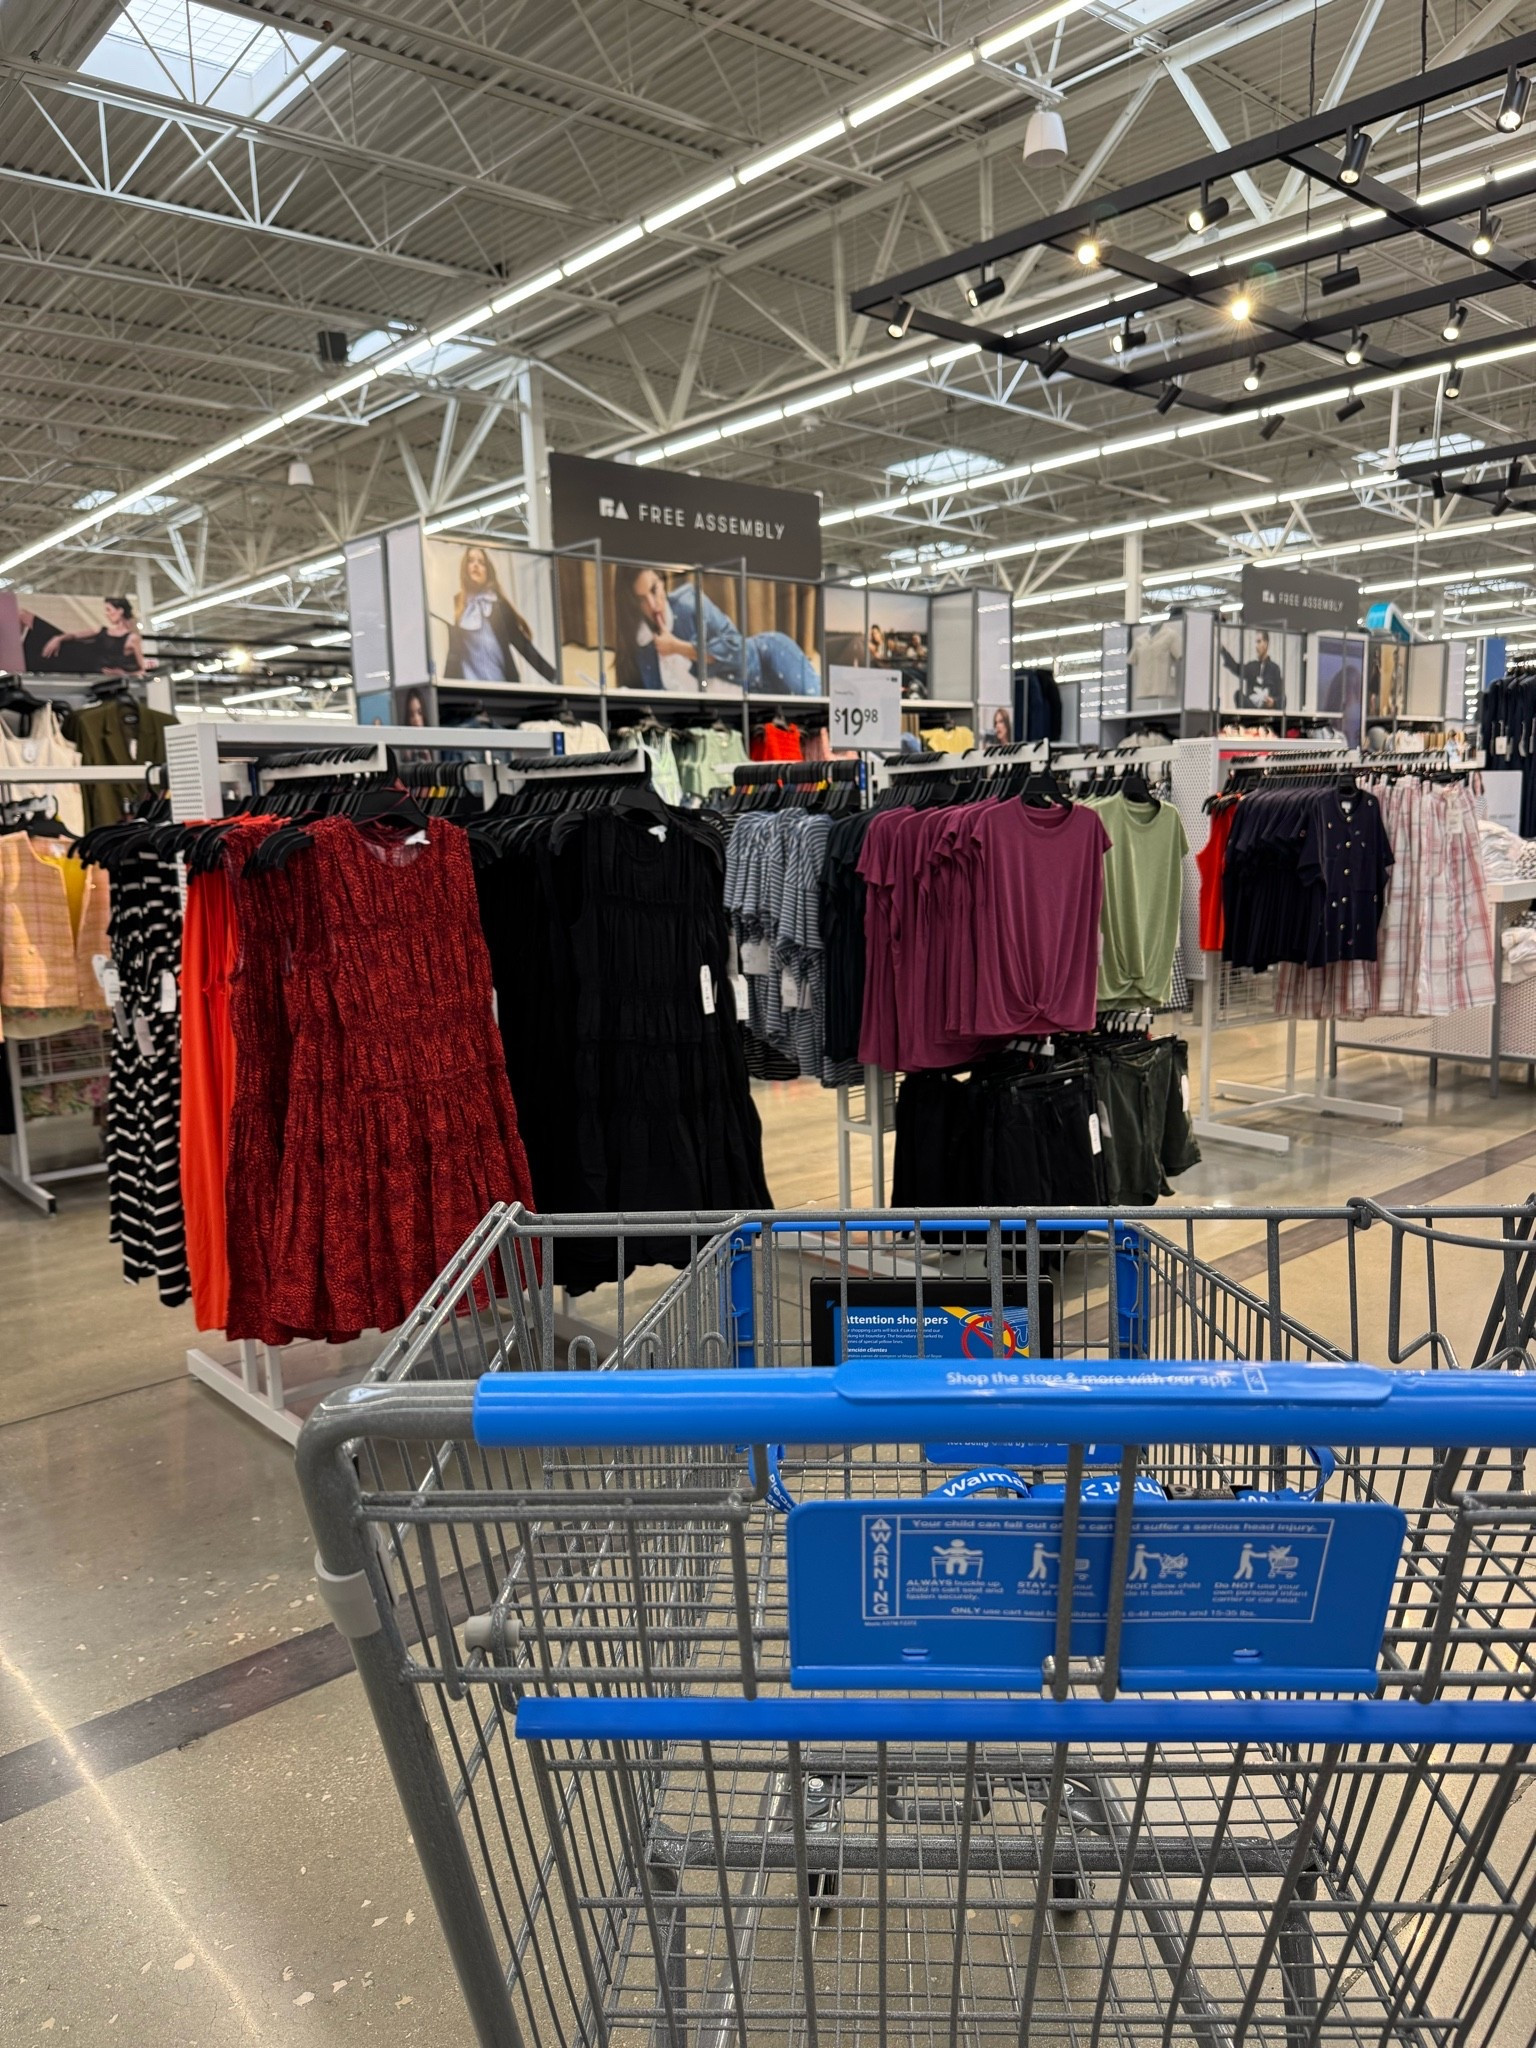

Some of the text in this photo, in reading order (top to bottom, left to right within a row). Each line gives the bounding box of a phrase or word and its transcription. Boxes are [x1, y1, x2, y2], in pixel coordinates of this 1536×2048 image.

[638, 503, 686, 528] FREE
[694, 512, 785, 540] ASSEMBLY
[1278, 592, 1300, 607] FREE
[1302, 596, 1344, 613] ASSEMBLY
[896, 1314, 949, 1327] shopers
[946, 1372, 988, 1387] Shop
[991, 1372, 1019, 1386] the
[1022, 1373, 1062, 1386] store
[1066, 1372, 1079, 1385] &
[1082, 1374, 1124, 1385] more
[1128, 1372, 1165, 1386] with
[1167, 1374, 1196, 1386] our
[943, 1472, 1031, 1497] Walma
[912, 1519, 941, 1528] Your
[944, 1519, 975, 1528] child
[1004, 1520, 1023, 1529] fall
[1026, 1521, 1047, 1529] out
[1089, 1523, 1113, 1531] cart
[1143, 1522, 1179, 1531] suffer
[1193, 1522, 1240, 1531] serious
[1244, 1522, 1274, 1531] head
[1278, 1522, 1318, 1532] injury.
[871, 1531, 892, 1615] WARNING
[951, 1606, 980, 1614] ONLY
